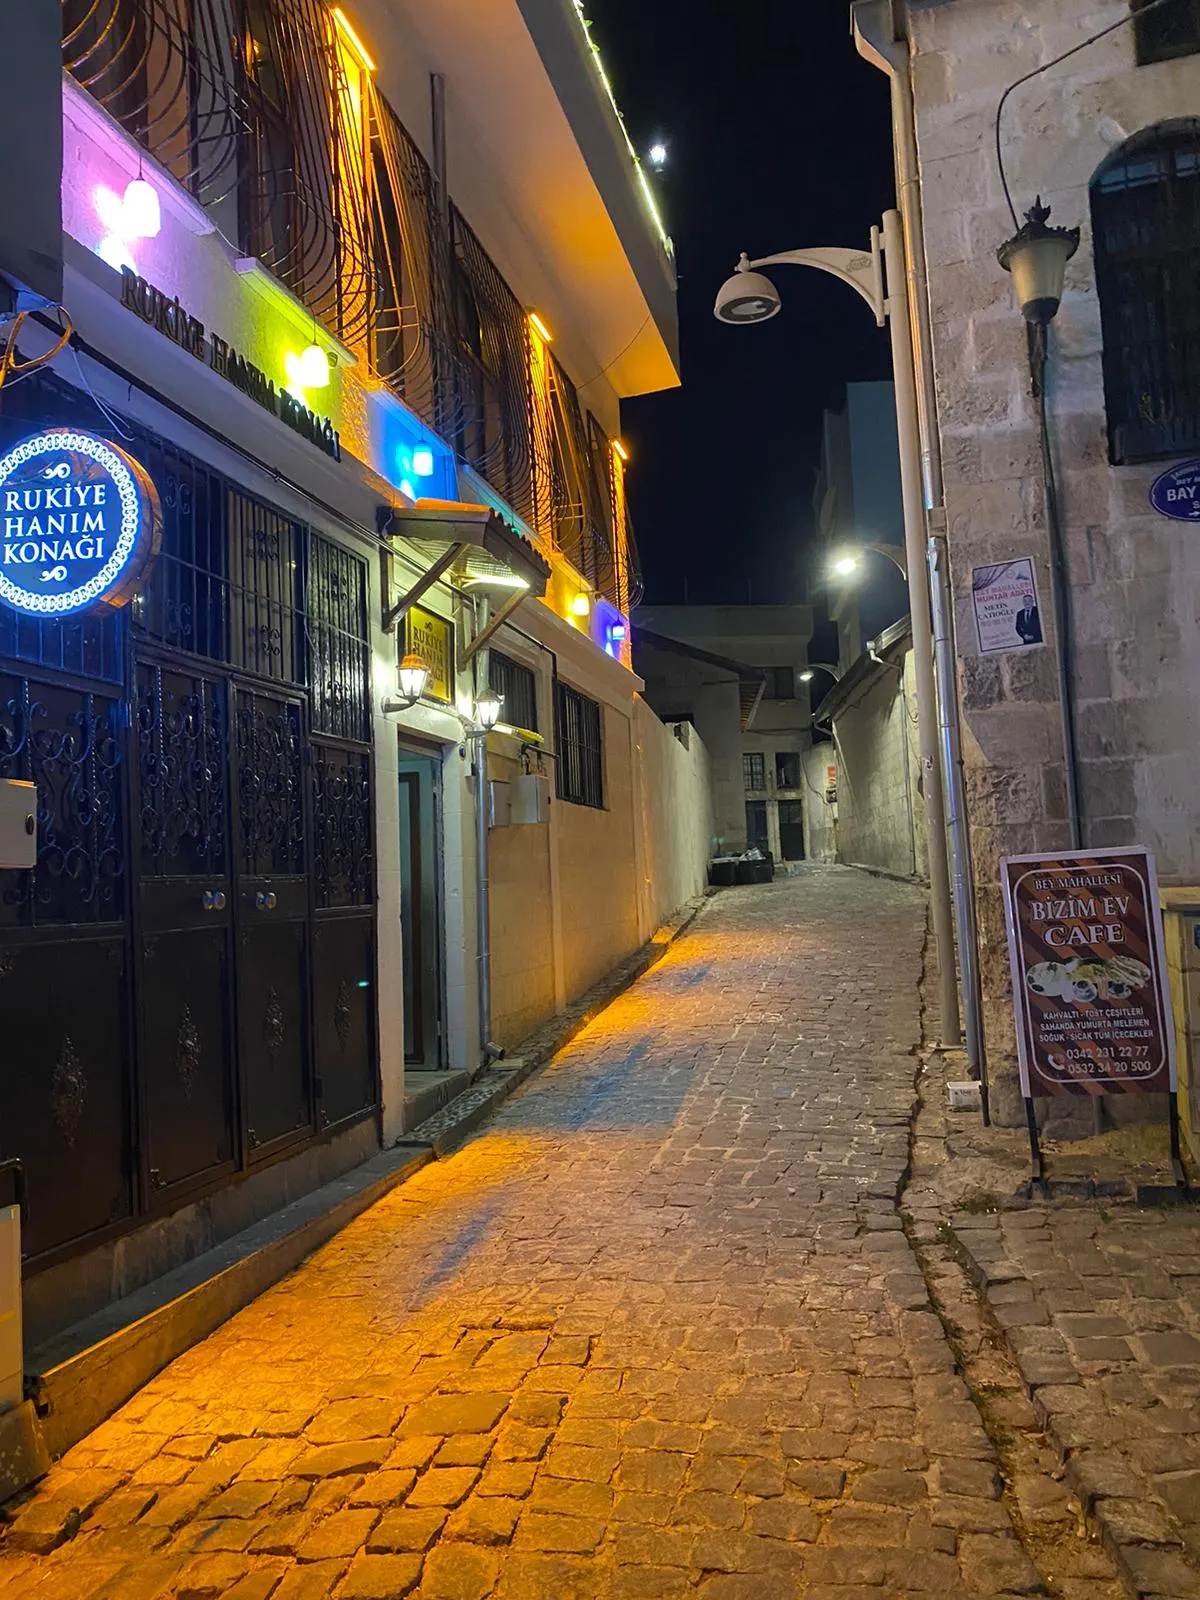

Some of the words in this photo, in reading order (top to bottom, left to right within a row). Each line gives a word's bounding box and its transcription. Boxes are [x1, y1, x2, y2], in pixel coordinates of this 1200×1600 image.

[5, 482, 106, 512] RUKİYE
[1166, 485, 1197, 502] BAY
[4, 511, 106, 538] HANIM
[3, 534, 104, 565] KONAĞI
[1034, 878, 1054, 890] BEY
[1031, 896, 1097, 921] BİZİM
[1104, 896, 1130, 916] EV
[1044, 923, 1125, 946] CAFE
[1043, 1010, 1079, 1020] KAHVALTI
[1085, 1009, 1103, 1018] TOST
[1040, 1023, 1074, 1031] SAHANDA
[1077, 1020, 1112, 1029] YUMURTA
[1040, 1032, 1065, 1042] SOĞUK
[1066, 1048, 1092, 1059] 0342
[1096, 1047, 1115, 1058] 231
[1119, 1047, 1132, 1057] 22
[1135, 1045, 1149, 1056] 77
[1068, 1063, 1095, 1074] 0532
[1115, 1061, 1128, 1072] 20
[1131, 1060, 1151, 1071] 500
